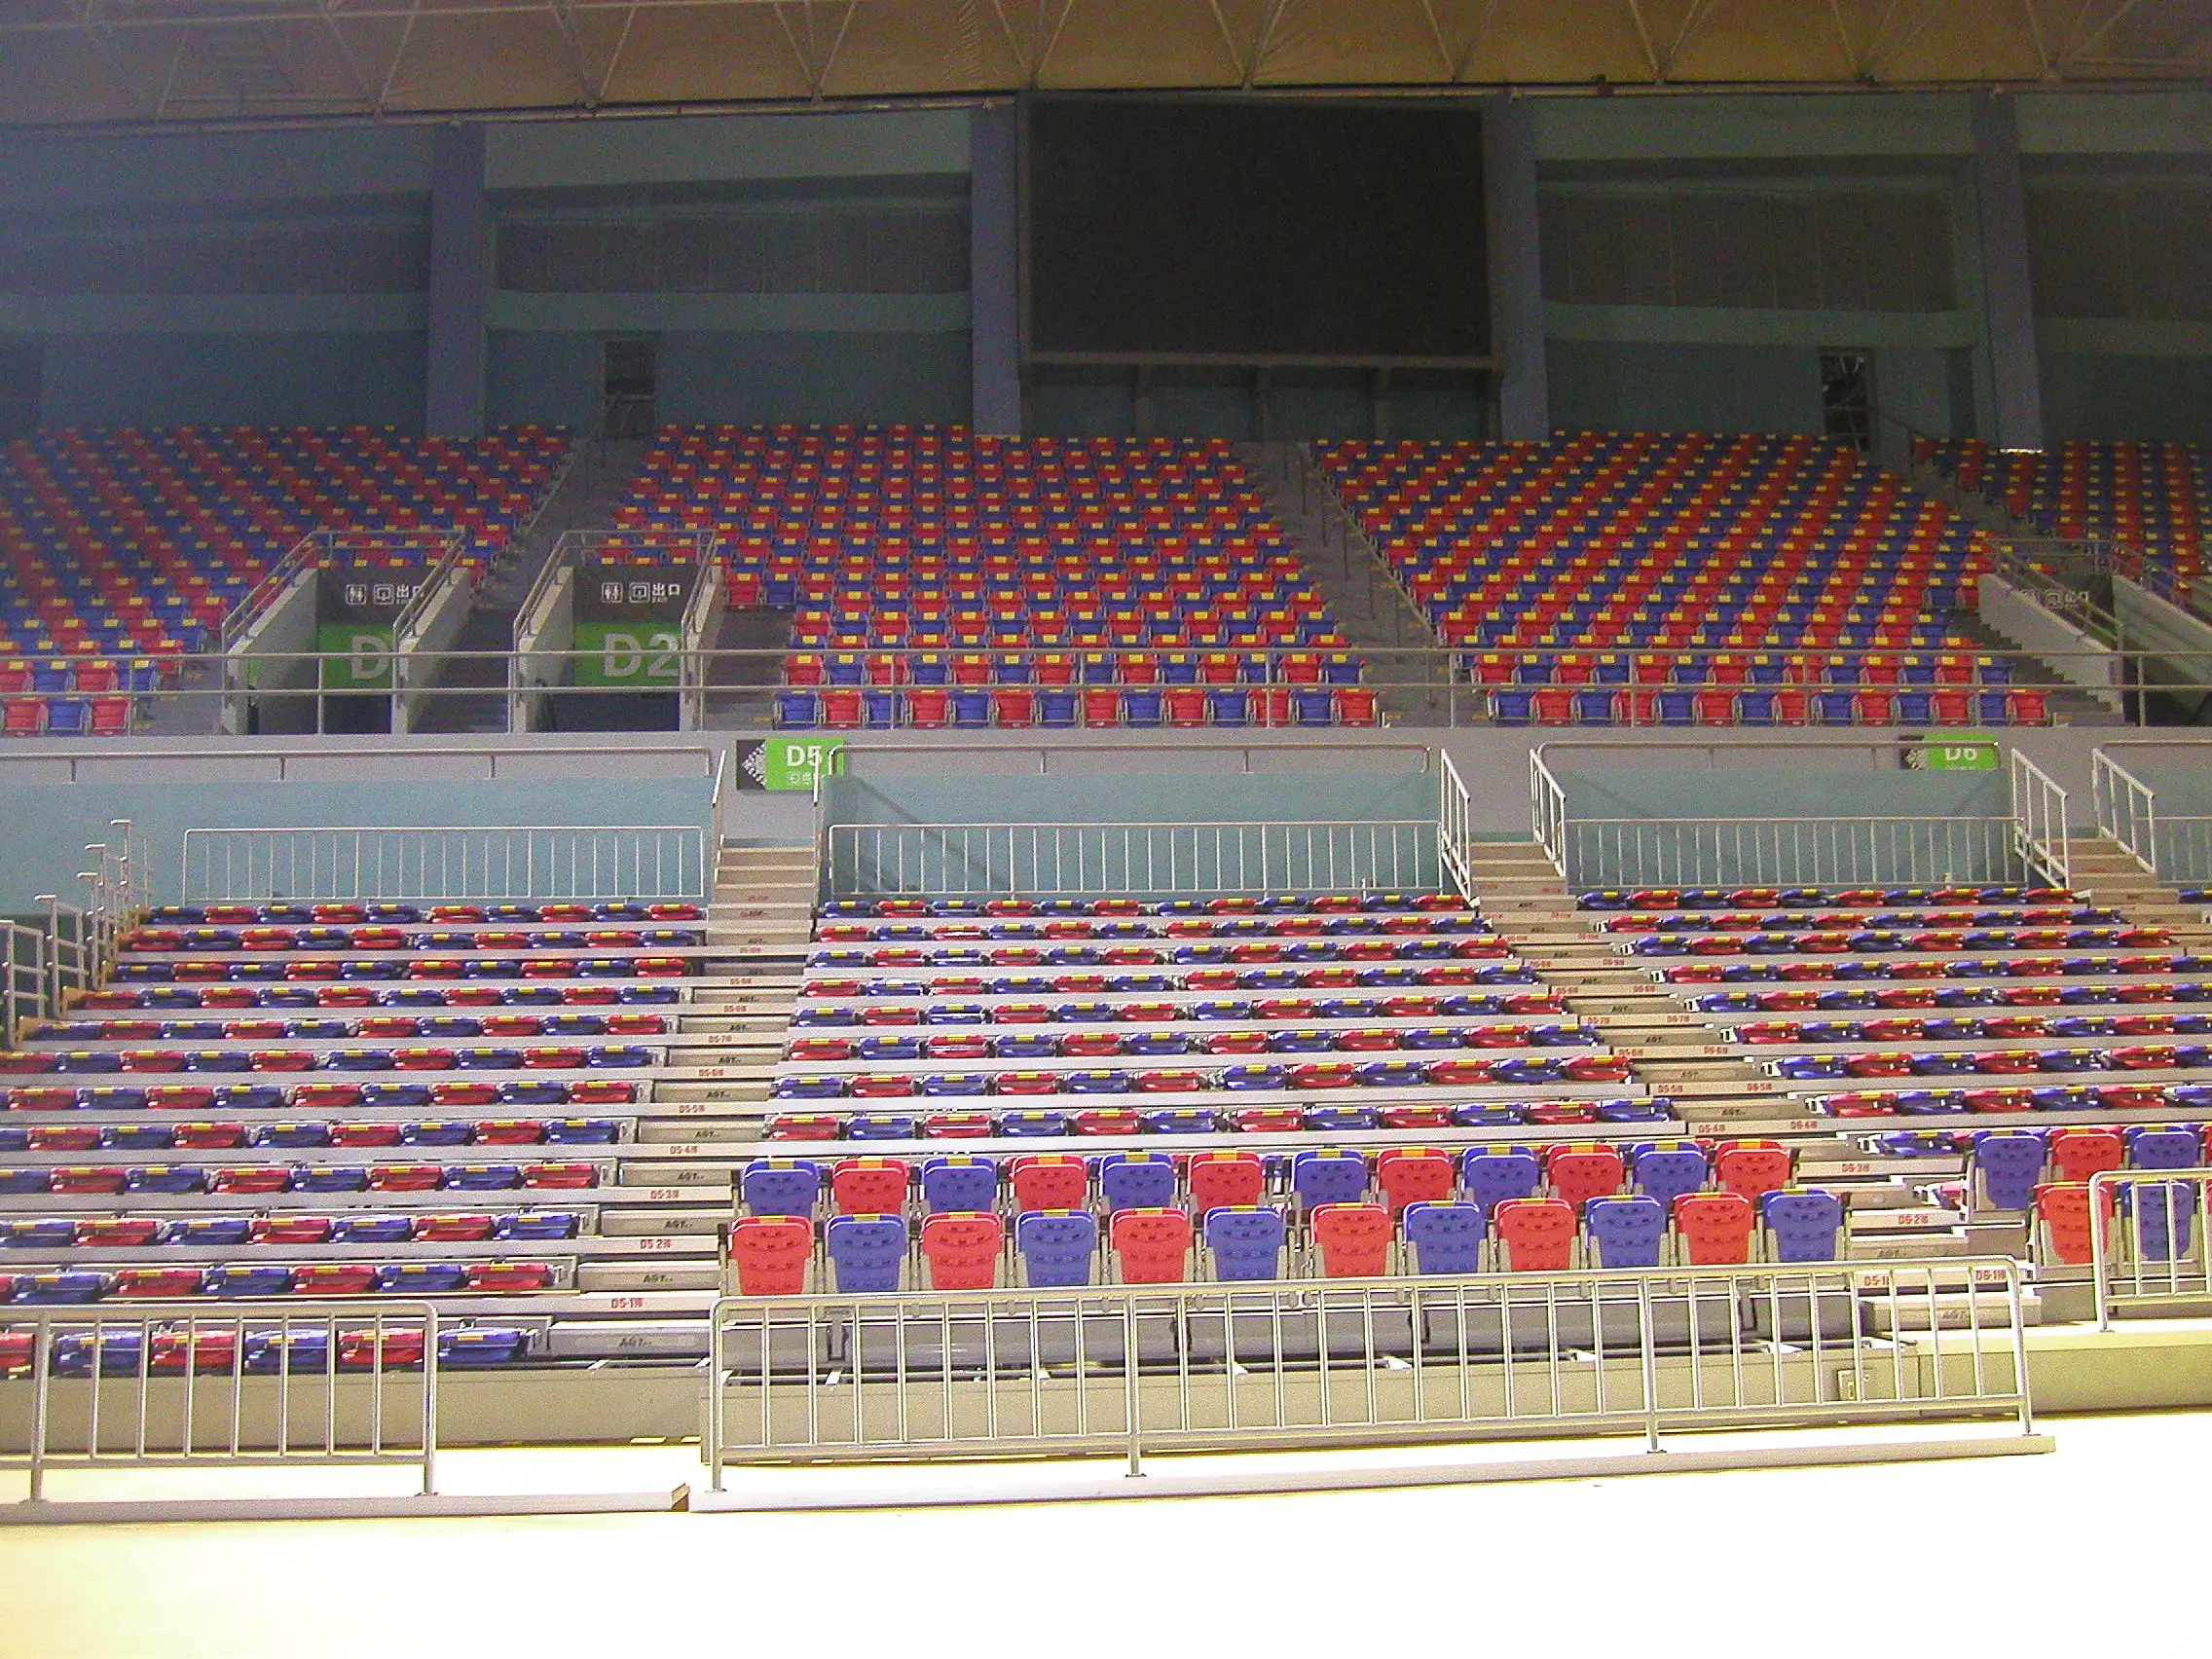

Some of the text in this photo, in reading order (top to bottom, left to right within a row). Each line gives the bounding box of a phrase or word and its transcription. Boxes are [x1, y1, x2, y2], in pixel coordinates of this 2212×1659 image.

[652, 583, 681, 596] 出口
[605, 633, 680, 678] D2
[787, 745, 823, 767] D5
